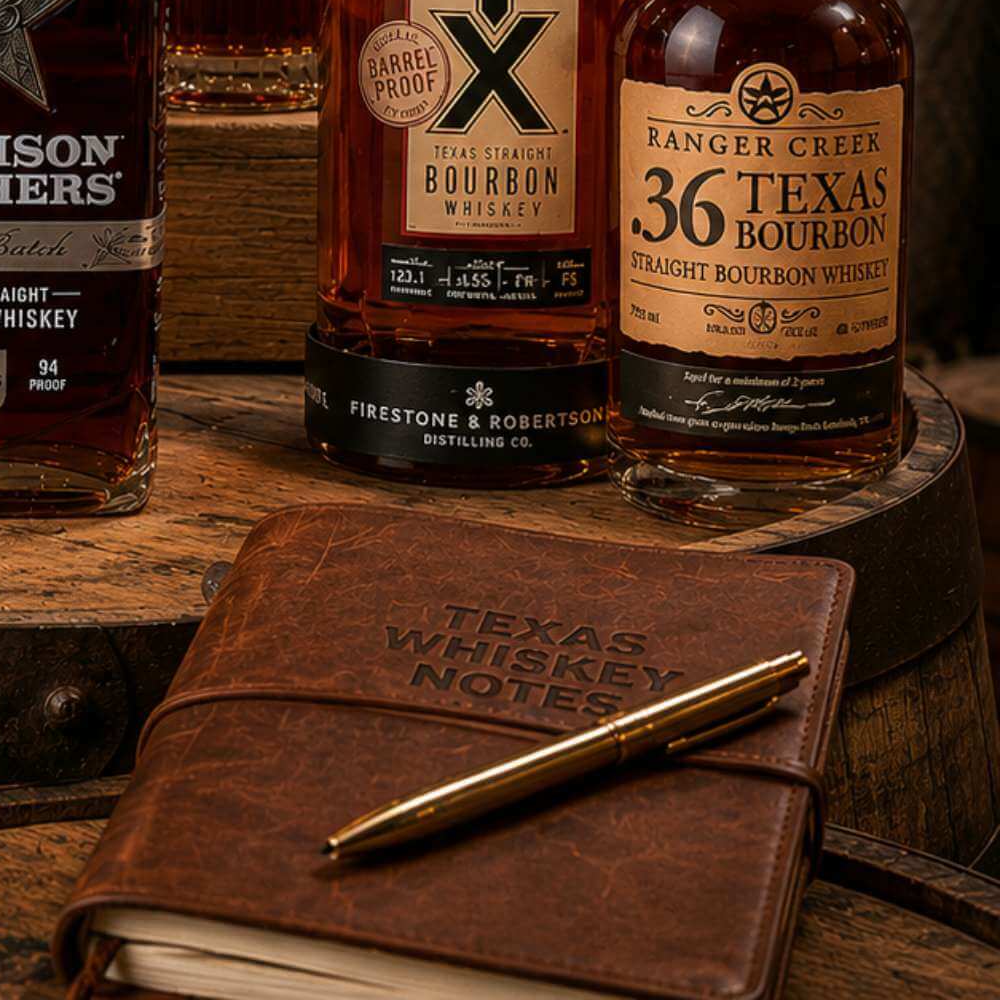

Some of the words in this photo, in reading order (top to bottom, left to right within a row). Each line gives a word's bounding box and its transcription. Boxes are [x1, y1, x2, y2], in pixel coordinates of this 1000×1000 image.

[368, 47, 437, 78] BARREL
[374, 70, 437, 101] PROOF
[434, 145, 477, 160] TEXAS
[485, 145, 553, 160] STRAIGHT
[647, 126, 774, 157] RANGER
[788, 132, 880, 157] CREEK
[425, 164, 559, 196] BOURBON
[444, 200, 542, 217] WHISKEY
[631, 167, 726, 248] .36
[736, 166, 888, 215] TEXAS
[735, 213, 887, 251] BOURBON
[631, 250, 709, 281] STRAIGHT
[715, 264, 817, 286] BOURBON
[822, 258, 889, 285] WHISKEY
[39, 359, 58, 376] 94
[29, 378, 67, 392] PROOF
[350, 401, 458, 429] FIRESTONE
[468, 415, 480, 430] &
[490, 408, 603, 430] ROBERTSON
[423, 433, 505, 448] DISTILLING
[511, 436, 533, 448] CO.
[444, 604, 648, 657] TEXAS
[385, 625, 685, 693] WHISKEY
[409, 662, 624, 718] NOTES
